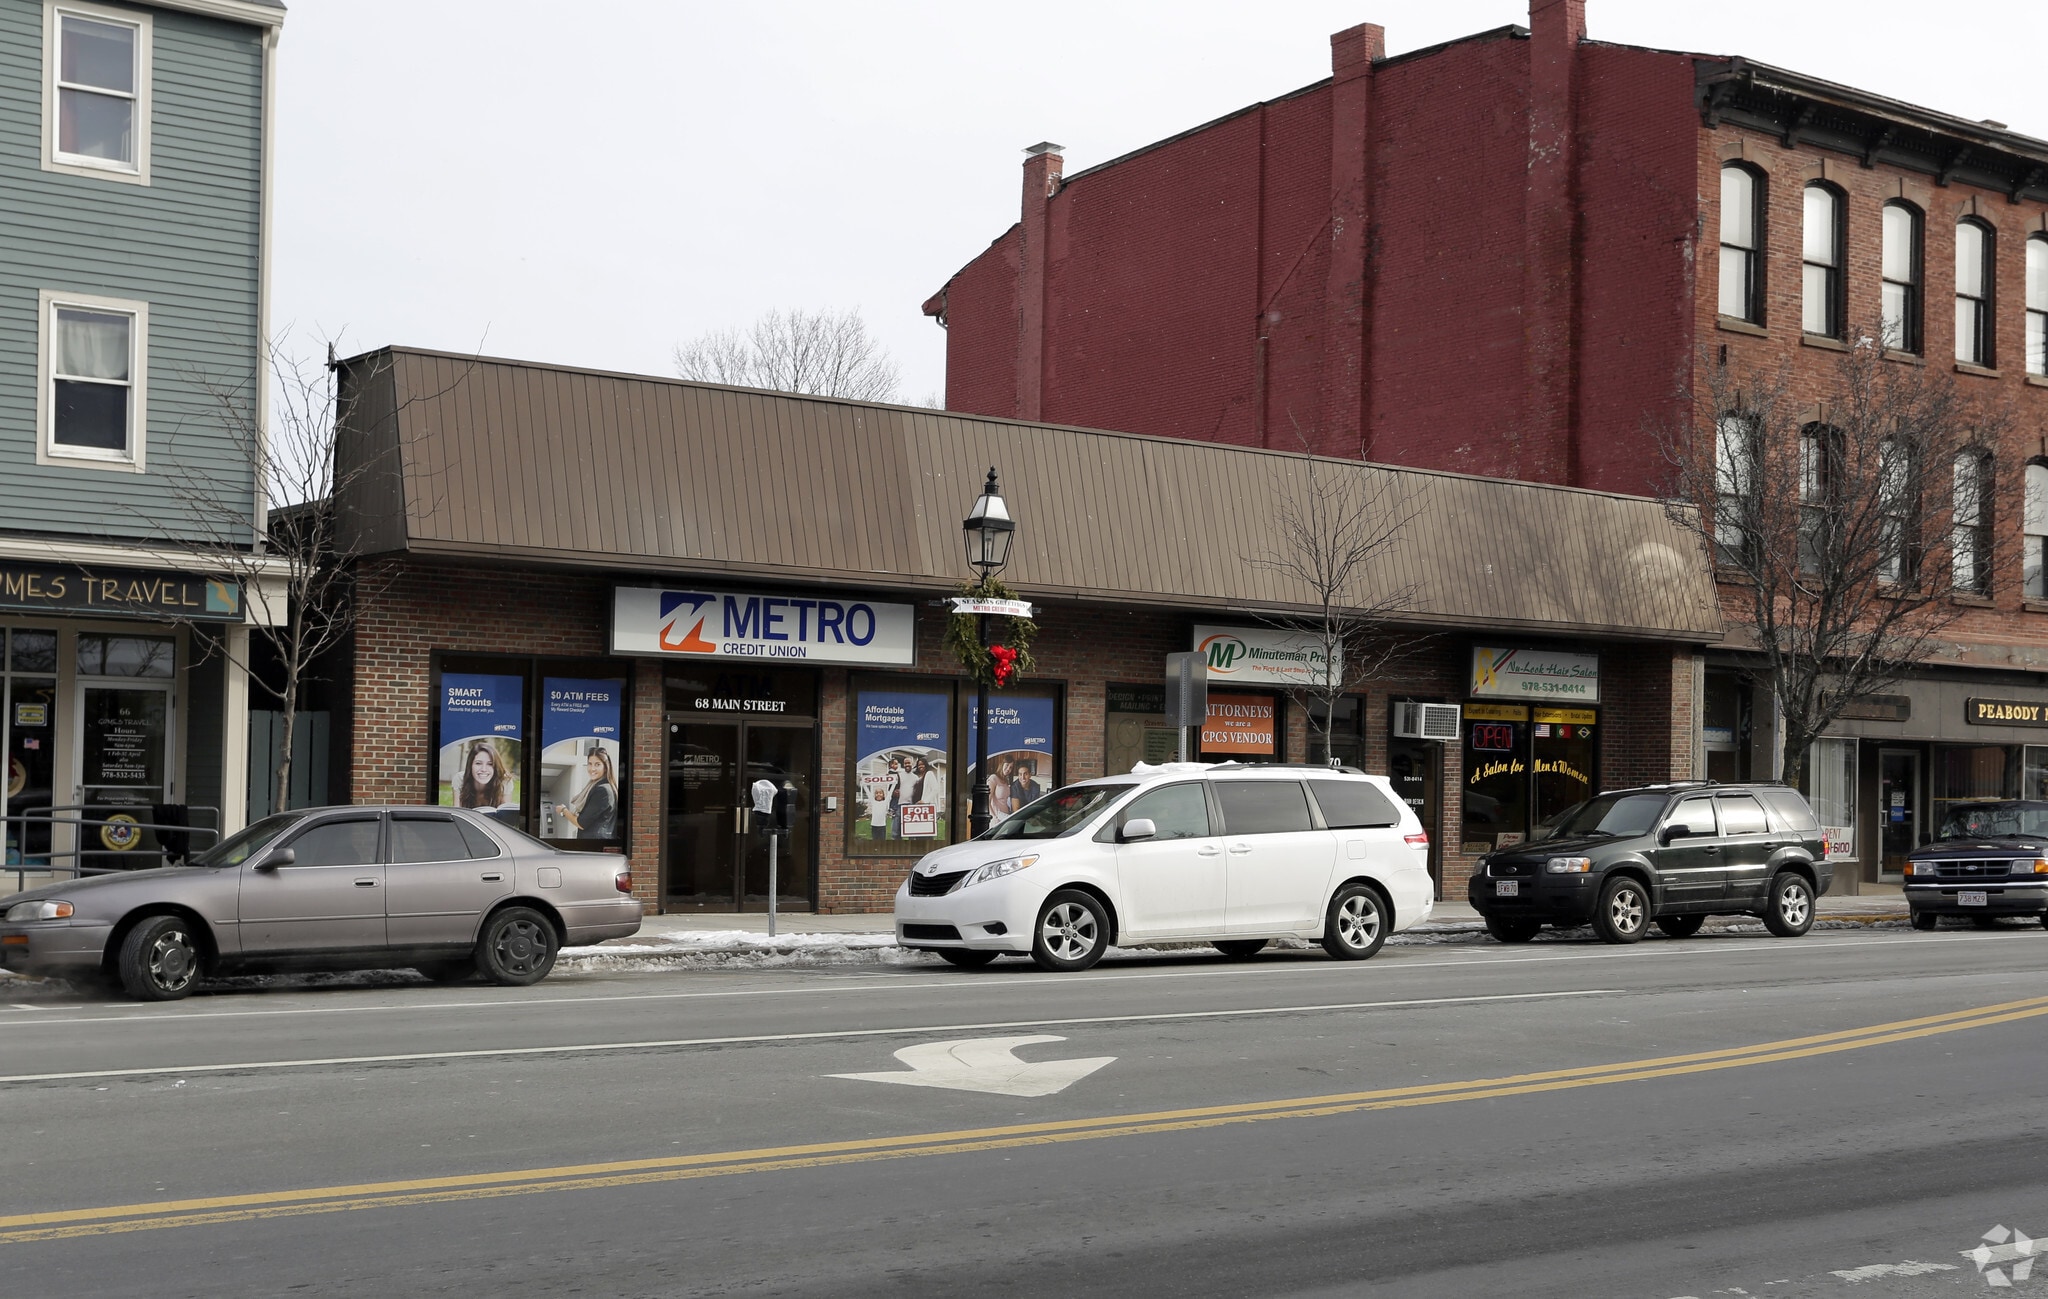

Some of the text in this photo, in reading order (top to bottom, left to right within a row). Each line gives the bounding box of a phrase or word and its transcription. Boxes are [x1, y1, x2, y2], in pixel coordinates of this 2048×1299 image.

[0, 572, 199, 606] MES TRAVEL
[723, 595, 876, 647] METRO
[723, 643, 807, 658] CREDIT UNION
[1248, 647, 1338, 664] Minuteman Pres
[1505, 661, 1598, 678] Nu-Look Hair Salon
[448, 687, 483, 698] SMART
[1521, 681, 1586, 694] 978-531-0414
[447, 697, 492, 707] Accounts
[550, 690, 609, 702] $0 ATM FEES
[695, 698, 786, 712] 68 MAIN STREET
[865, 705, 904, 714] Affordable
[1205, 703, 1272, 719] ATTORNEYS!
[119, 707, 131, 716] 66
[995, 708, 1018, 717] Equity
[1978, 703, 2039, 721] PEABODY
[865, 713, 905, 724] Mortgages
[990, 716, 1021, 725] of Credit
[1202, 730, 1273, 744] CPCS VENDOR
[1474, 726, 1512, 749] OPEN
[693, 755, 720, 763] METRO
[1330, 757, 1341, 766] 70
[1470, 758, 1588, 785] A Salon for Men & Women
[907, 806, 930, 814] FOR
[903, 813, 934, 822] SALE
